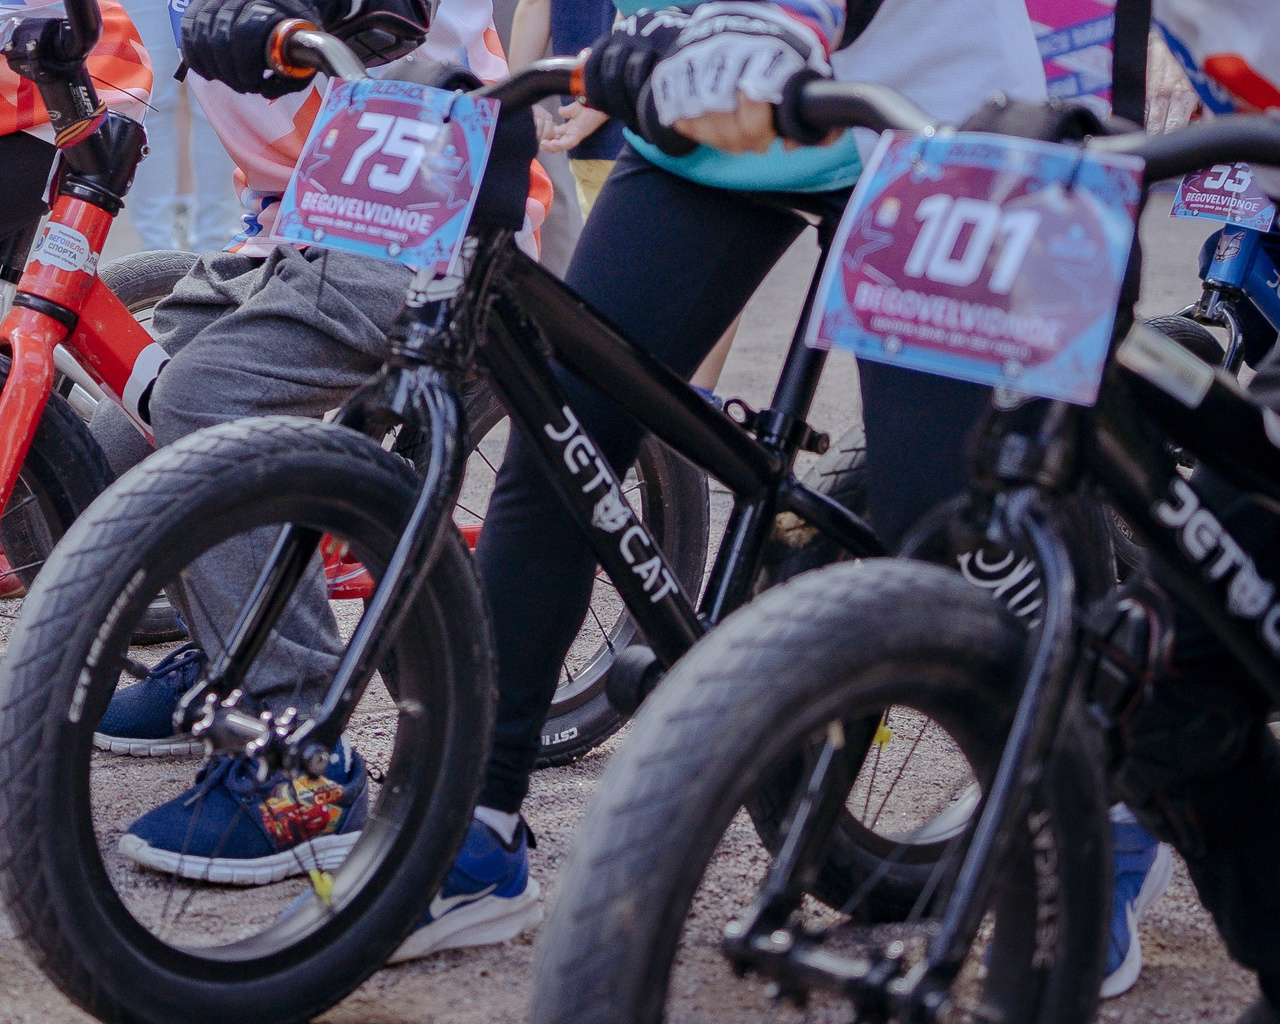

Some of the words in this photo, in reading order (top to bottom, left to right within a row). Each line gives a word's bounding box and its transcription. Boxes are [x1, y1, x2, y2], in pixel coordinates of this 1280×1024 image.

[341, 112, 440, 195] 75
[300, 191, 435, 236] BEGOVELVIDNOE
[1184, 192, 1260, 212] BEGOVELVIDNOE
[48, 242, 77, 261] СПОРТА
[903, 193, 1042, 296] 101
